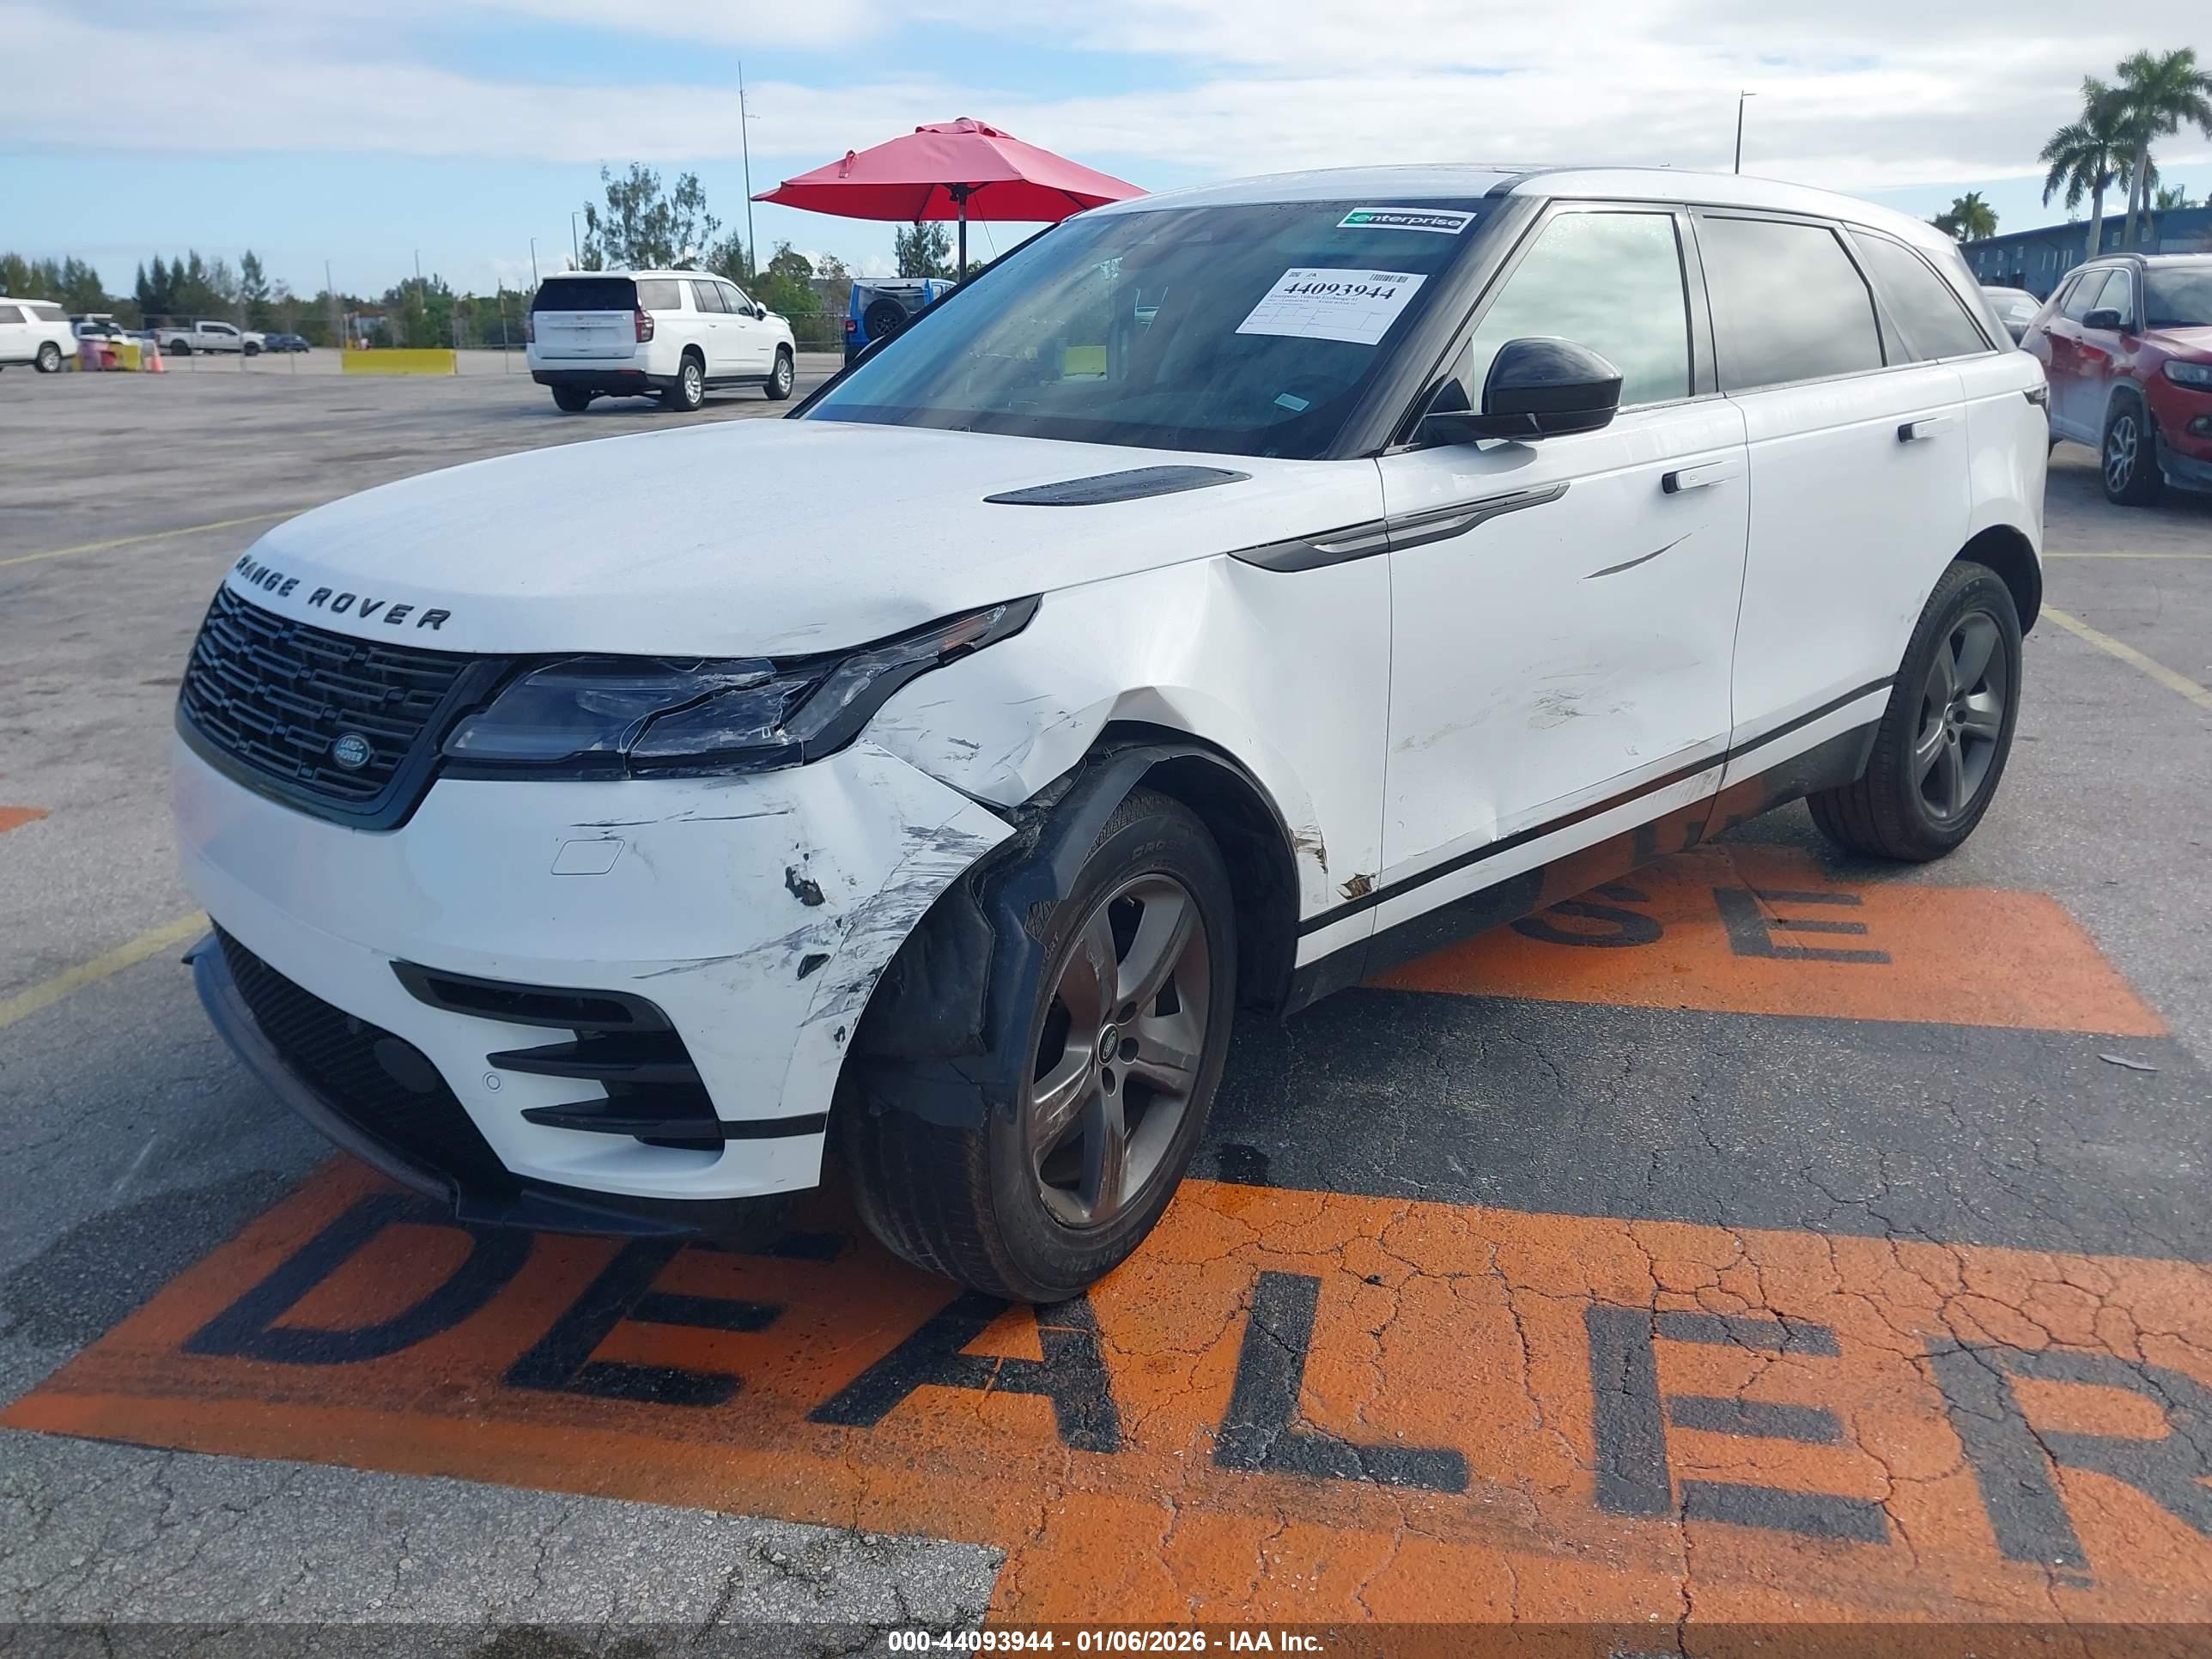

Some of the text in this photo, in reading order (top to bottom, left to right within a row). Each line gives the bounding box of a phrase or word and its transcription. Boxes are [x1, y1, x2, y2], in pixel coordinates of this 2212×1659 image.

[1347, 214, 1462, 227] enterprise
[1284, 282, 1397, 300] 44093944
[234, 554, 452, 630] RANGE ROVER
[180, 1194, 2212, 1584] DEALER
